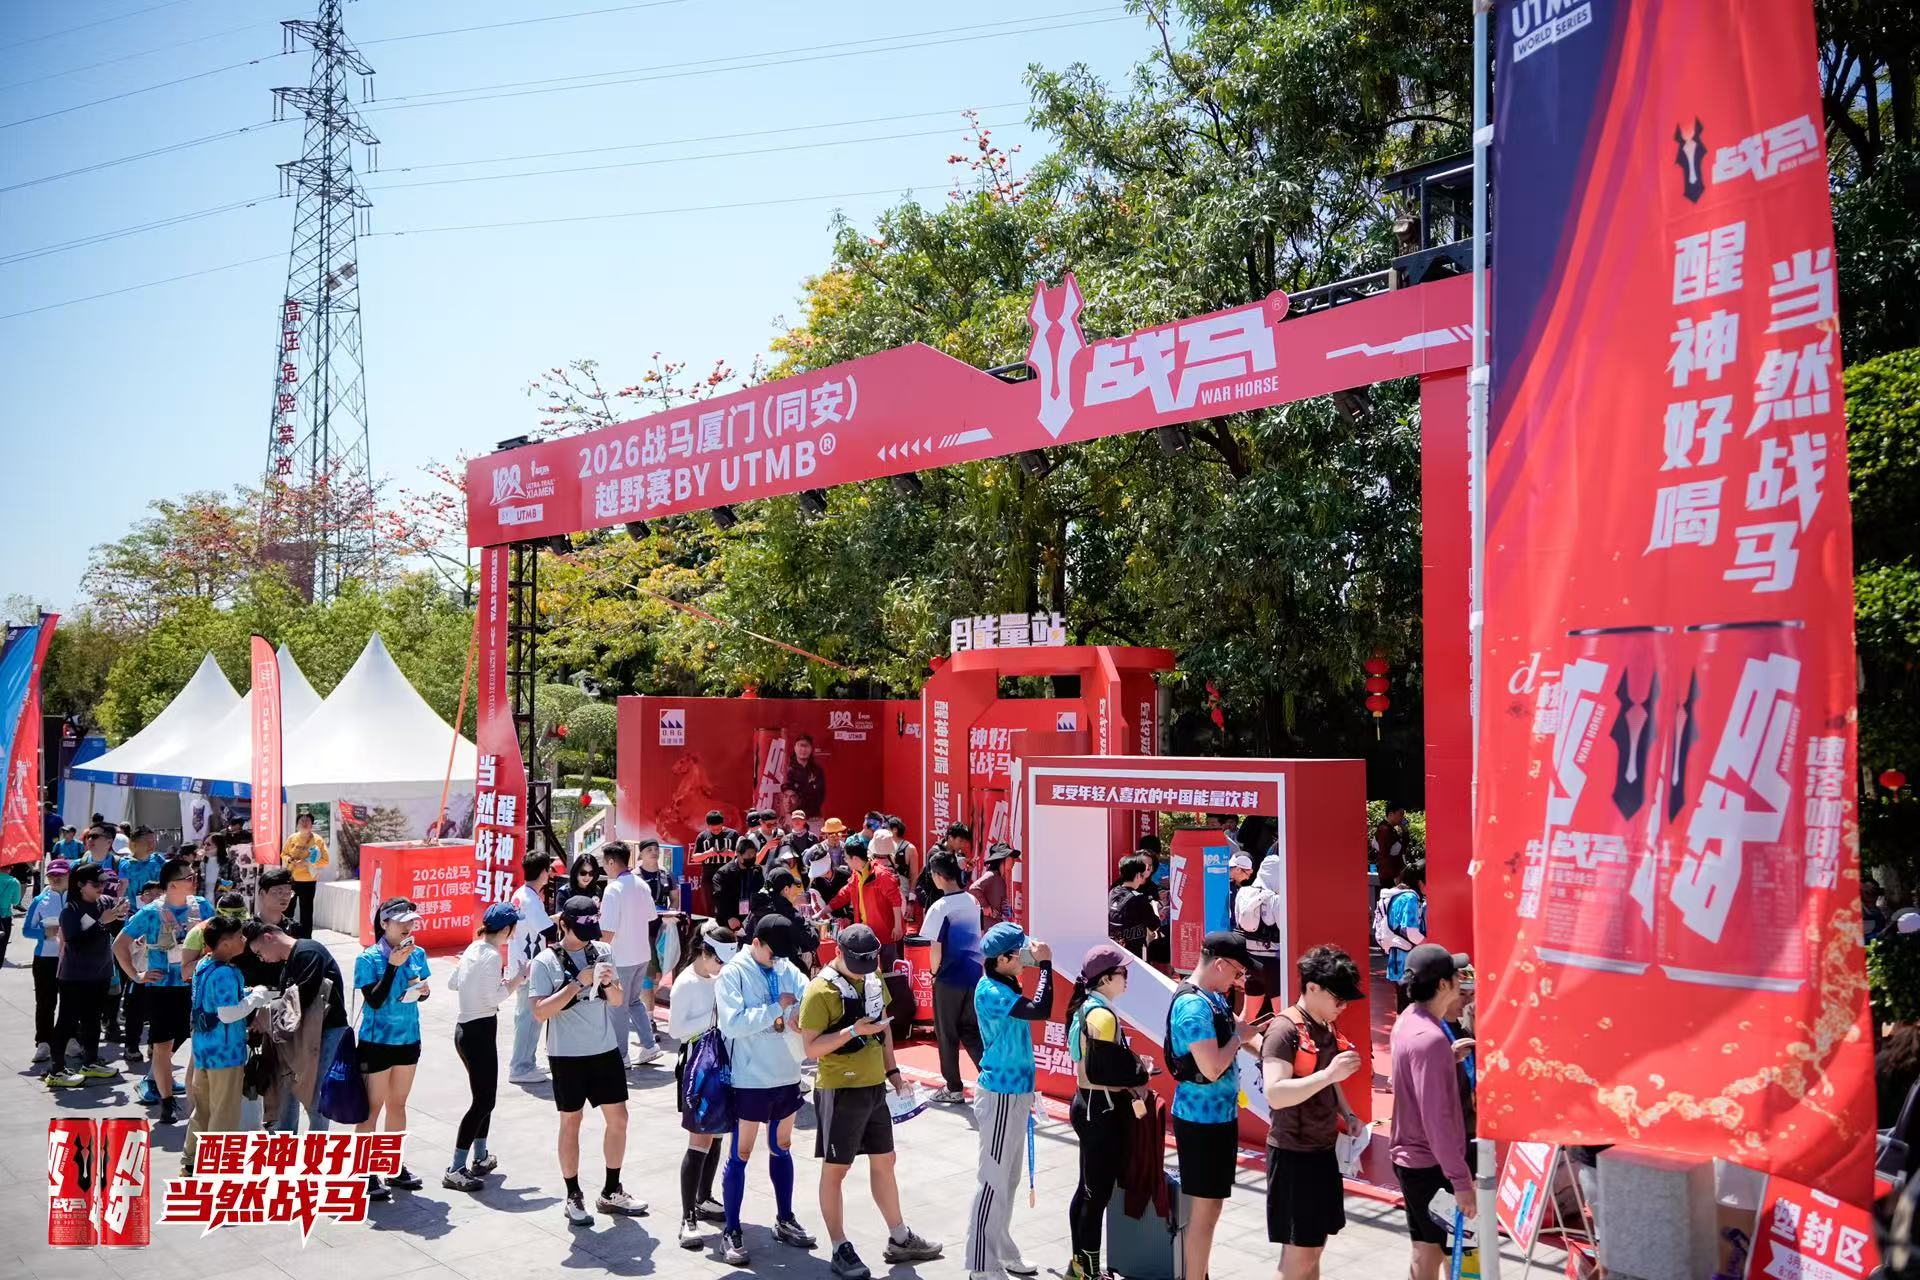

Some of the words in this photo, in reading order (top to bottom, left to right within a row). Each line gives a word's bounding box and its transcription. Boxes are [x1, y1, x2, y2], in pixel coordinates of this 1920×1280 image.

[1512, 0, 1582, 37] UTM
[1518, 27, 1552, 55] WORLD
[1555, 9, 1588, 36] SERIES
[1201, 385, 1231, 405] WAR
[1235, 376, 1279, 399] HORSE
[1642, 221, 1746, 556] 醒神好喝
[1723, 246, 1834, 592] 当然战马
[526, 486, 555, 499] XIAMEN
[517, 508, 537, 520] UTMB
[970, 727, 1011, 751] 神好
[930, 781, 949, 843] 当然战
[1051, 784, 1259, 809] 更受年轻人喜欢的中国能量饮料
[475, 754, 496, 903] 当然战马
[494, 795, 517, 903] 醒神好
[412, 866, 471, 882] 2026战马
[1034, 969, 1048, 1003] SUUNTO
[1033, 1044, 1077, 1077] 当然
[1770, 1197, 1868, 1273] 塑封区
